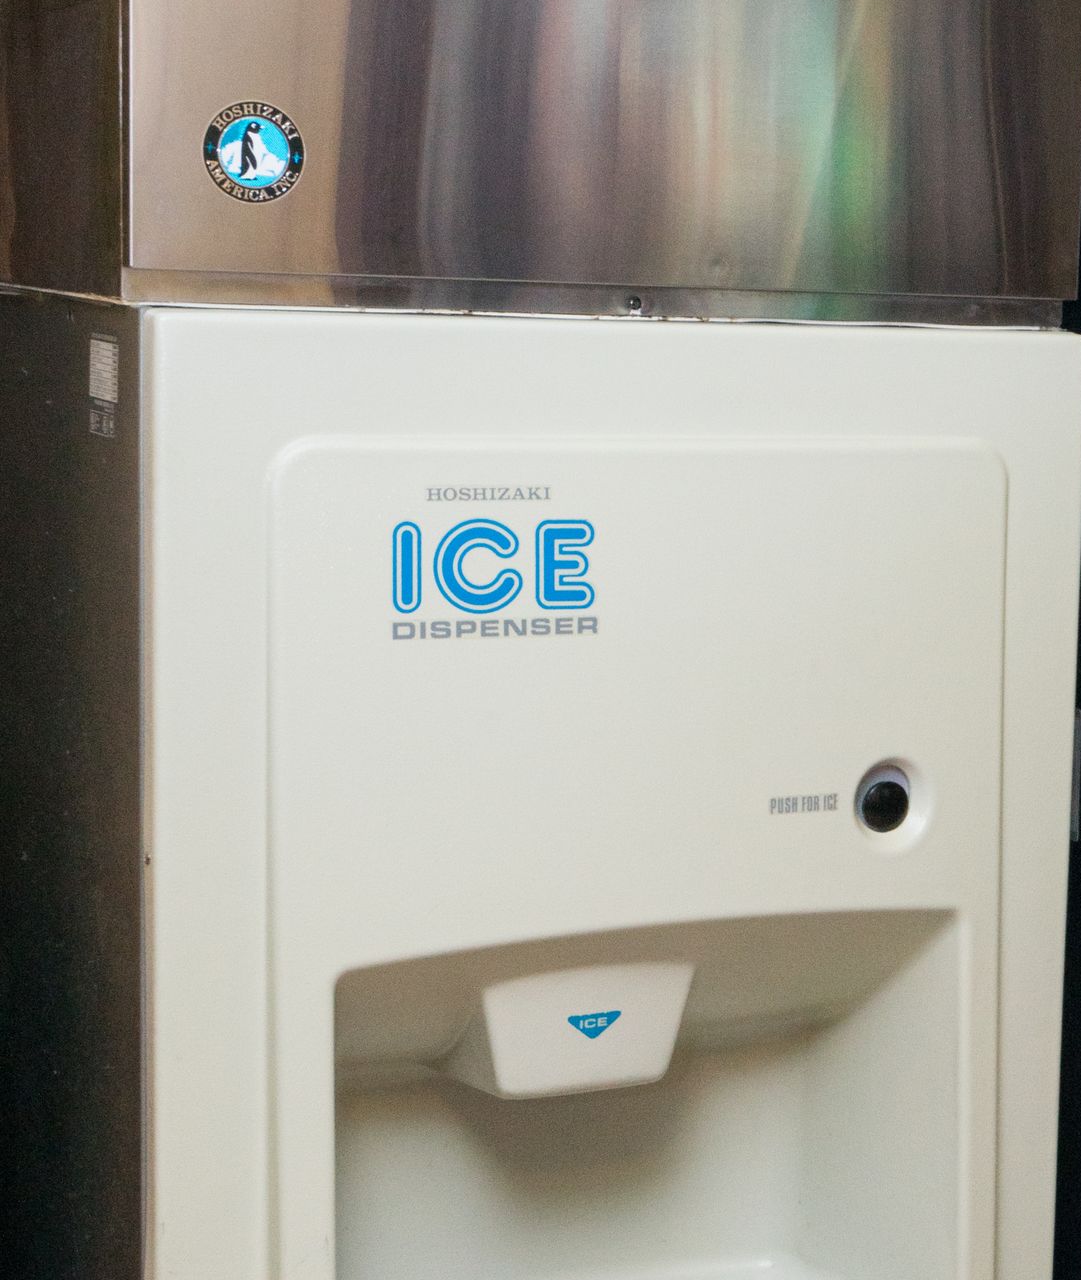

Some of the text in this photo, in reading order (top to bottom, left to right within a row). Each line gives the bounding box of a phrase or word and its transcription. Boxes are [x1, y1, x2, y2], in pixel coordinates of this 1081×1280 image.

[211, 103, 299, 140] HOSHIZAKI
[272, 170, 299, 196] INC.
[427, 486, 551, 501] HOSHIZAKI
[393, 518, 595, 614] ICE
[392, 616, 598, 640] DISPENSER
[770, 793, 838, 815] PUSH FOR ICE
[579, 1017, 608, 1029] ICE
